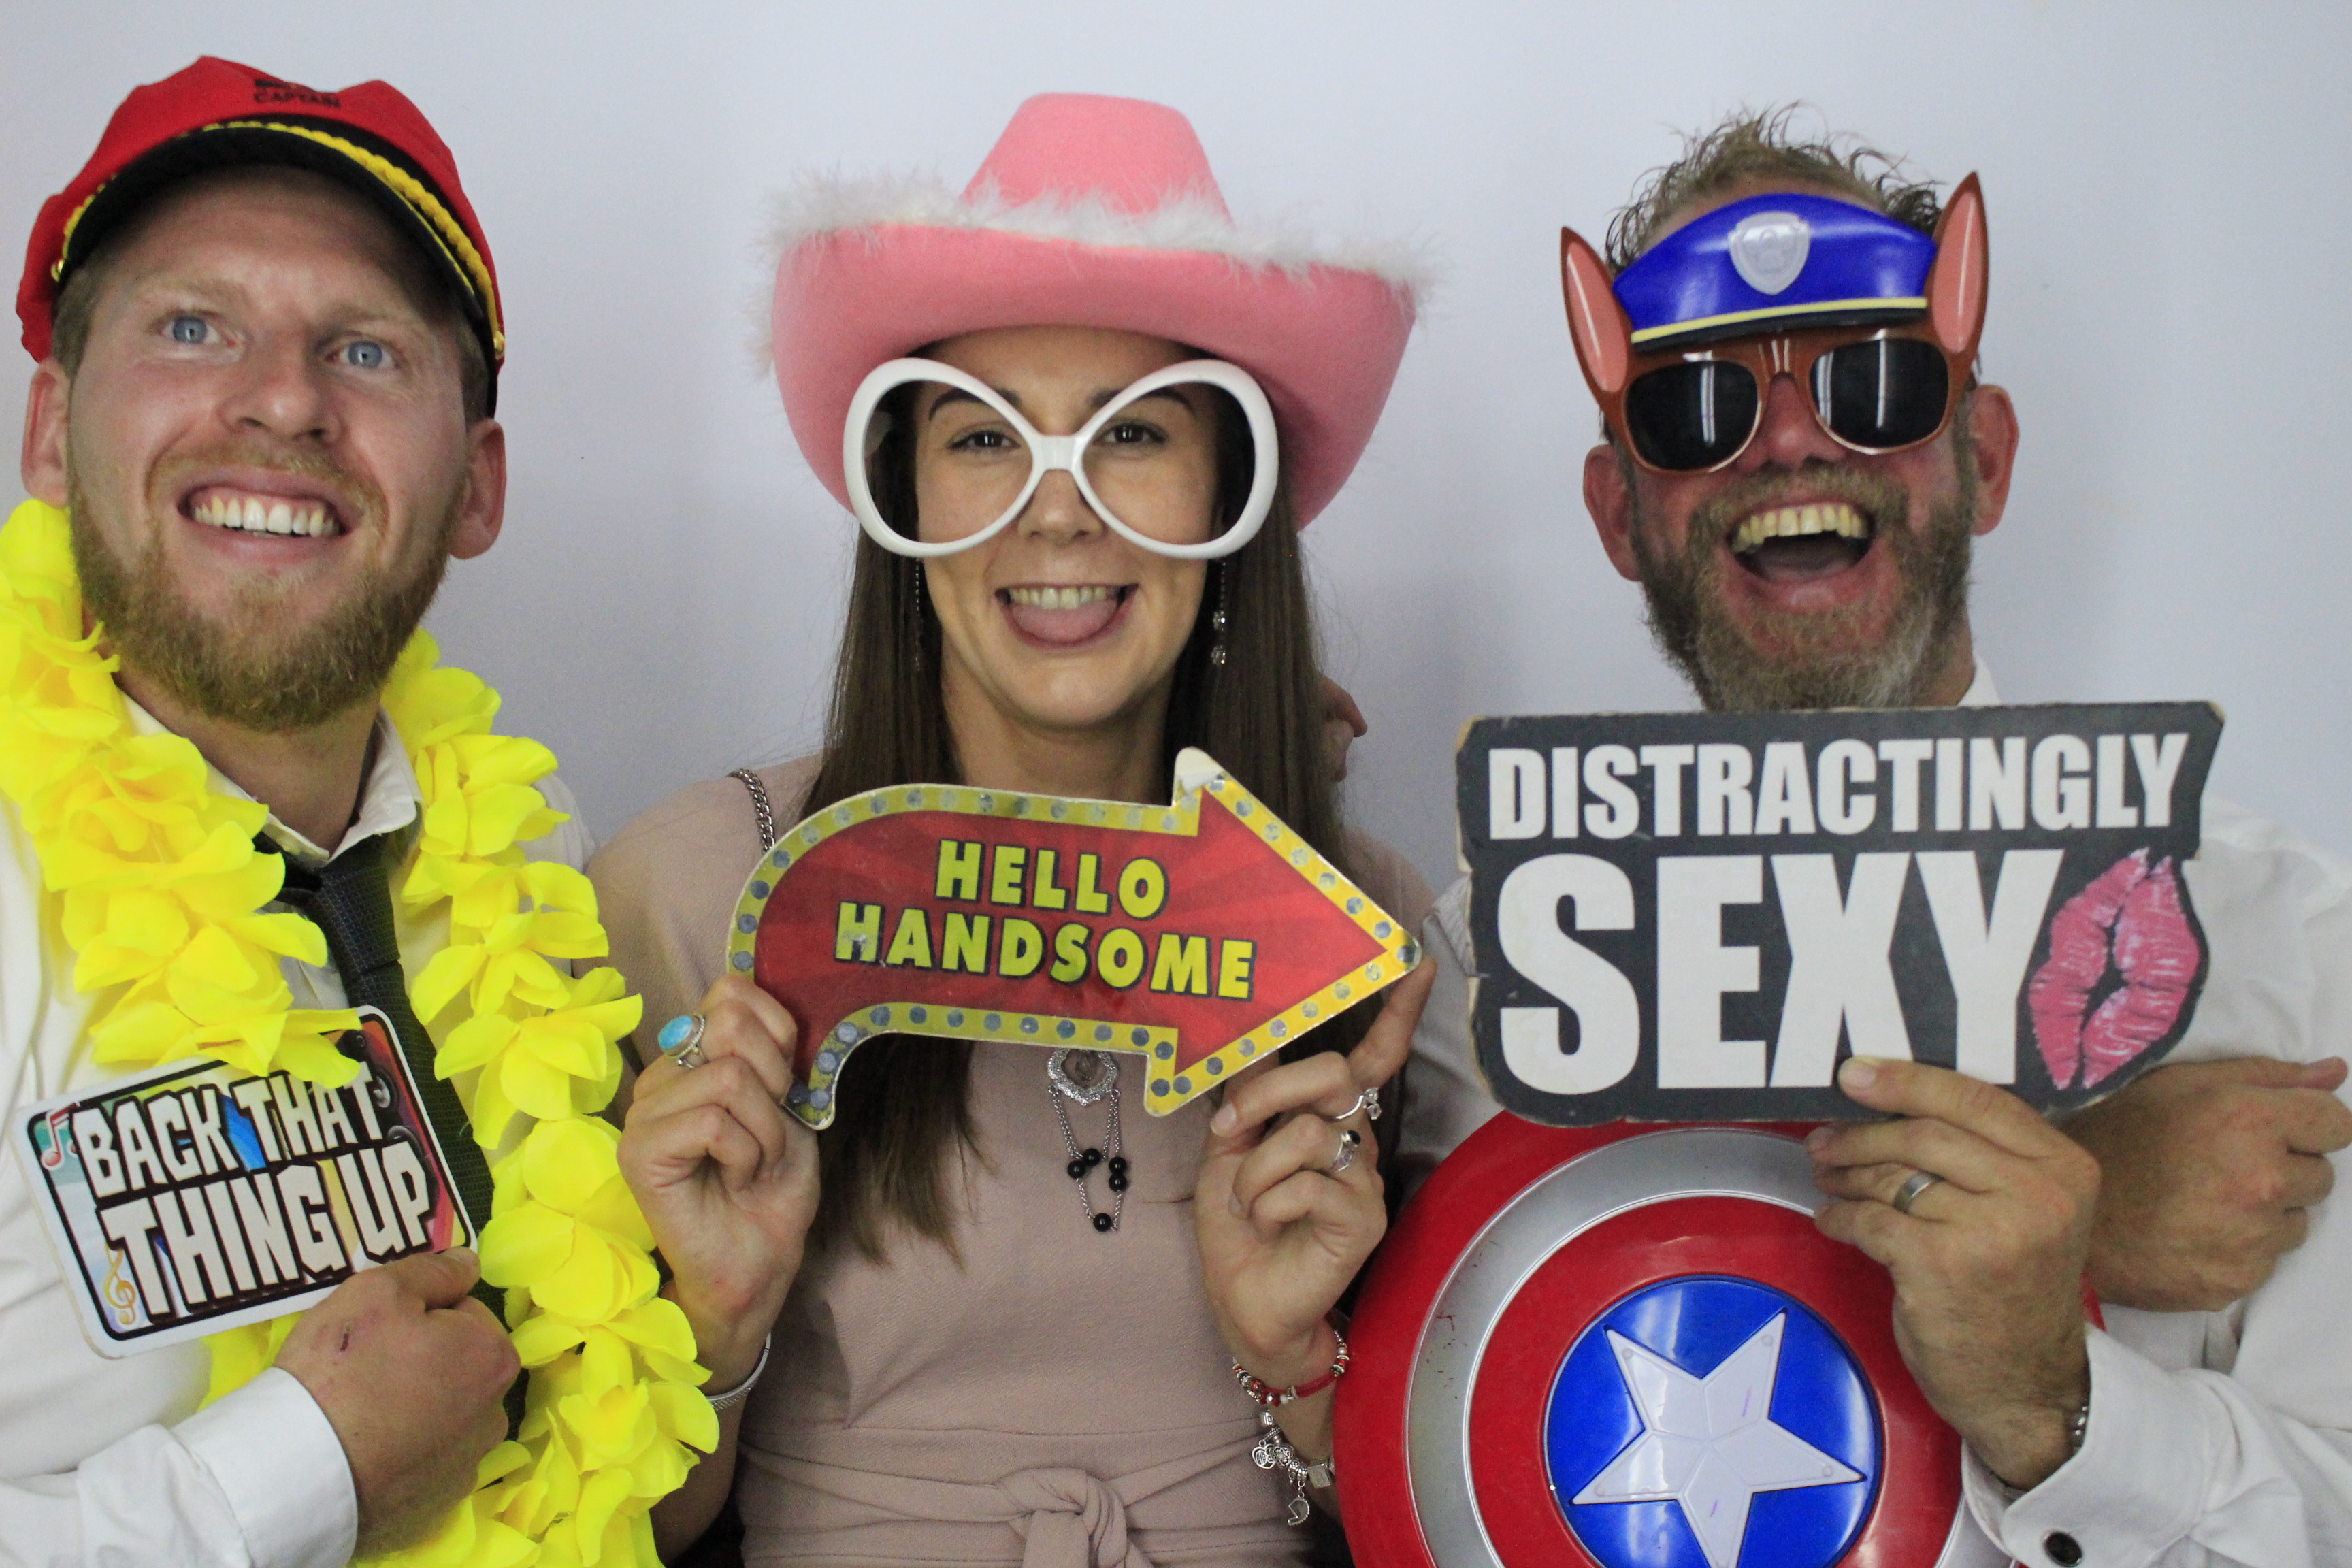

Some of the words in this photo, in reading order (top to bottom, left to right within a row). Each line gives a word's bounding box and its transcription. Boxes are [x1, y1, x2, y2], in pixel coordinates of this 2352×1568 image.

[1488, 732, 2189, 841] DISTRACTINGLY
[935, 839, 1168, 919] HELLO
[834, 901, 1255, 1000] HANDSOME
[1497, 848, 2064, 1095] SEXY
[71, 1083, 239, 1198] BACK
[231, 1061, 383, 1162] THAT
[100, 1164, 346, 1316] THING
[337, 1141, 431, 1260] UP
